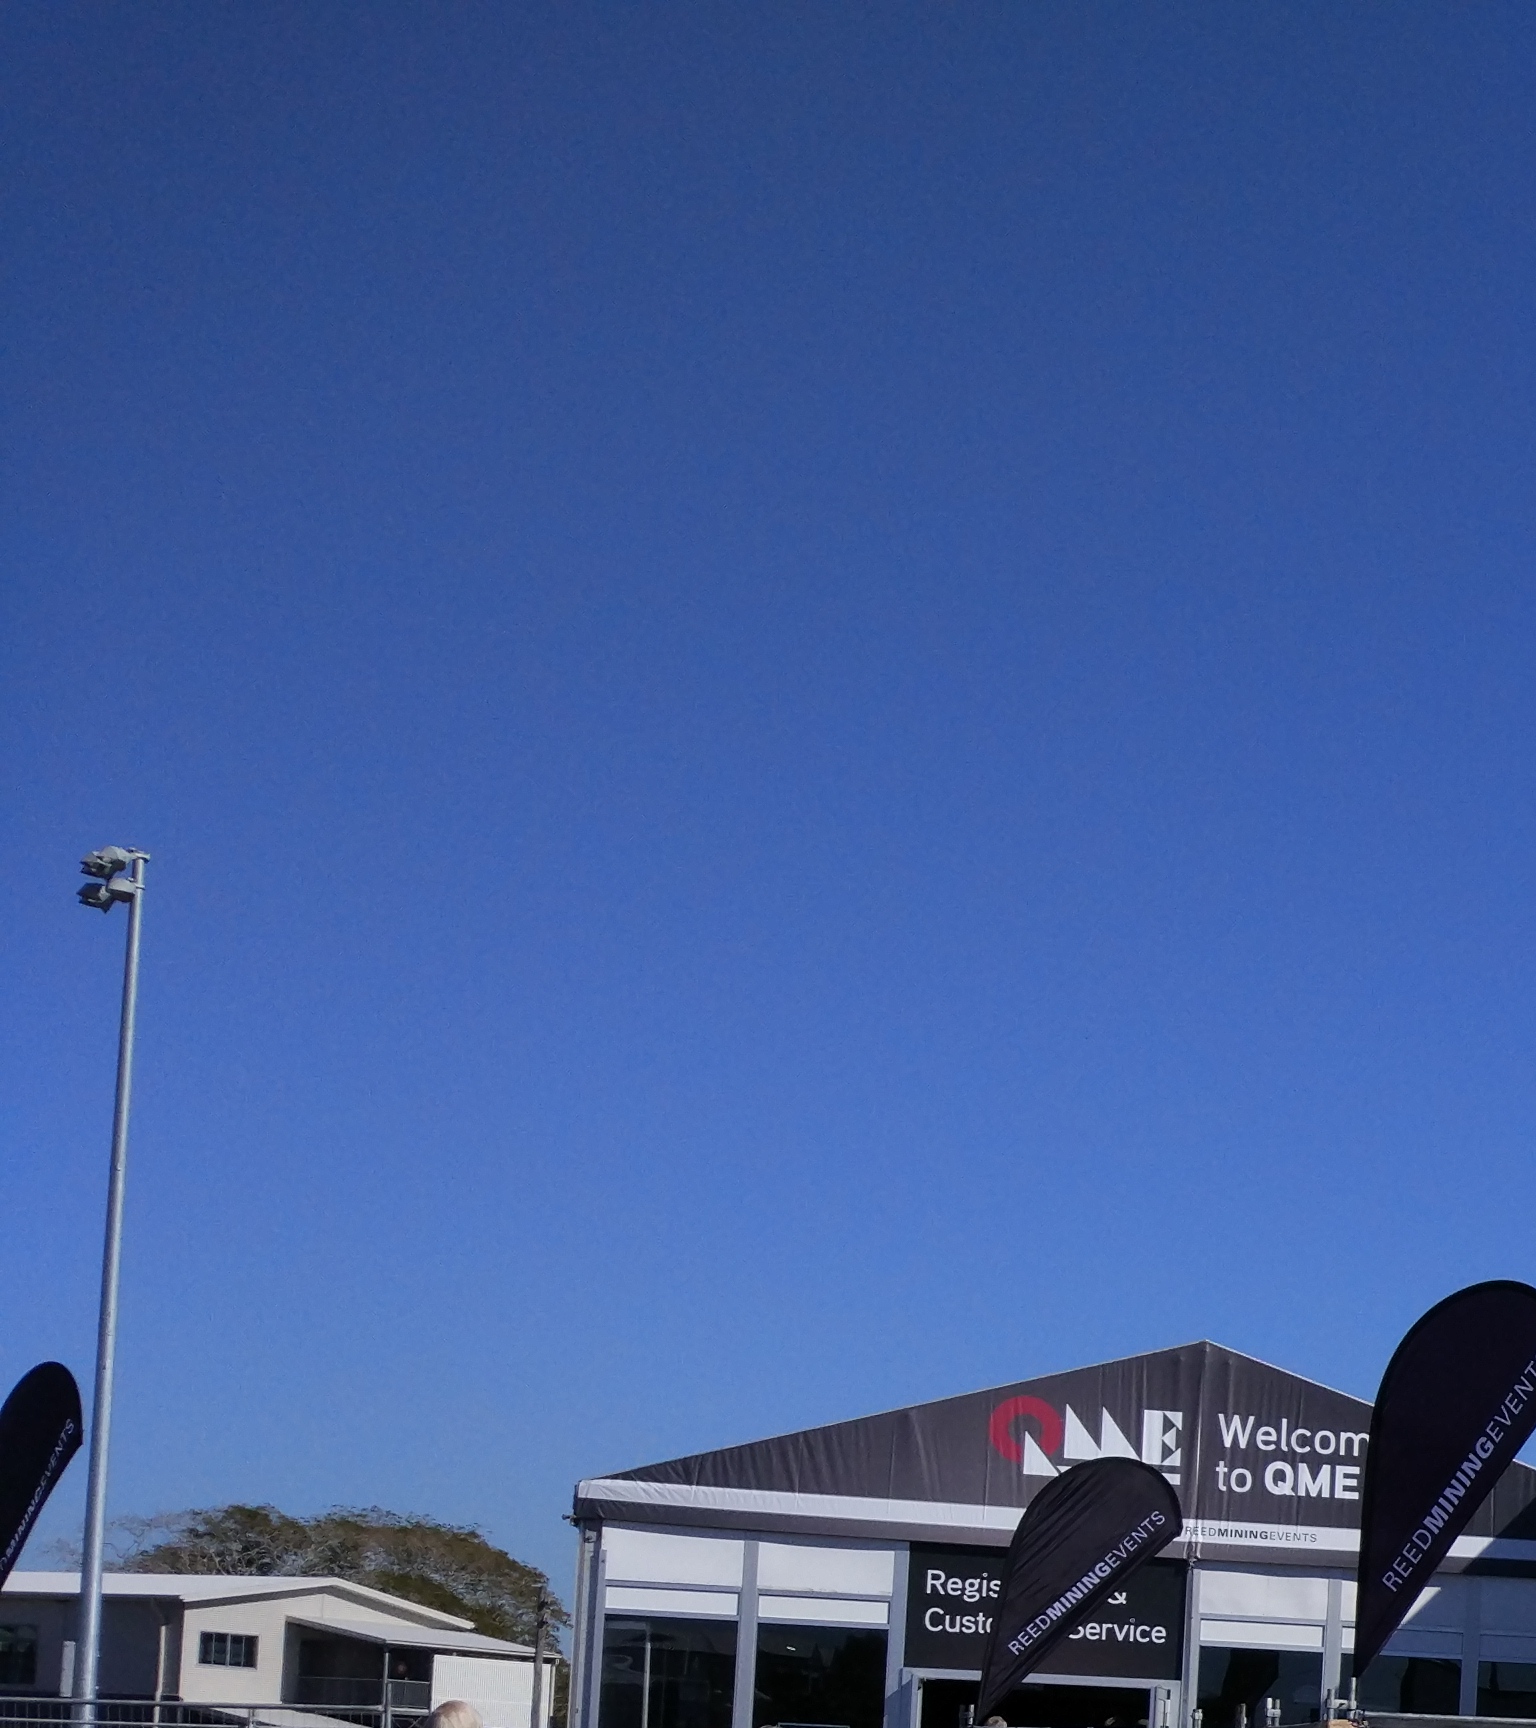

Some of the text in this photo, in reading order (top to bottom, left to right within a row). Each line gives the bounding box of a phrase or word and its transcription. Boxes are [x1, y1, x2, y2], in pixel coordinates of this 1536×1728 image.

[1217, 1413, 1370, 1457] Welcom
[1215, 1460, 1360, 1500] to QME
[926, 1569, 1001, 1603] Regis
[1008, 1510, 1166, 1656] REEDMININGEVENTS
